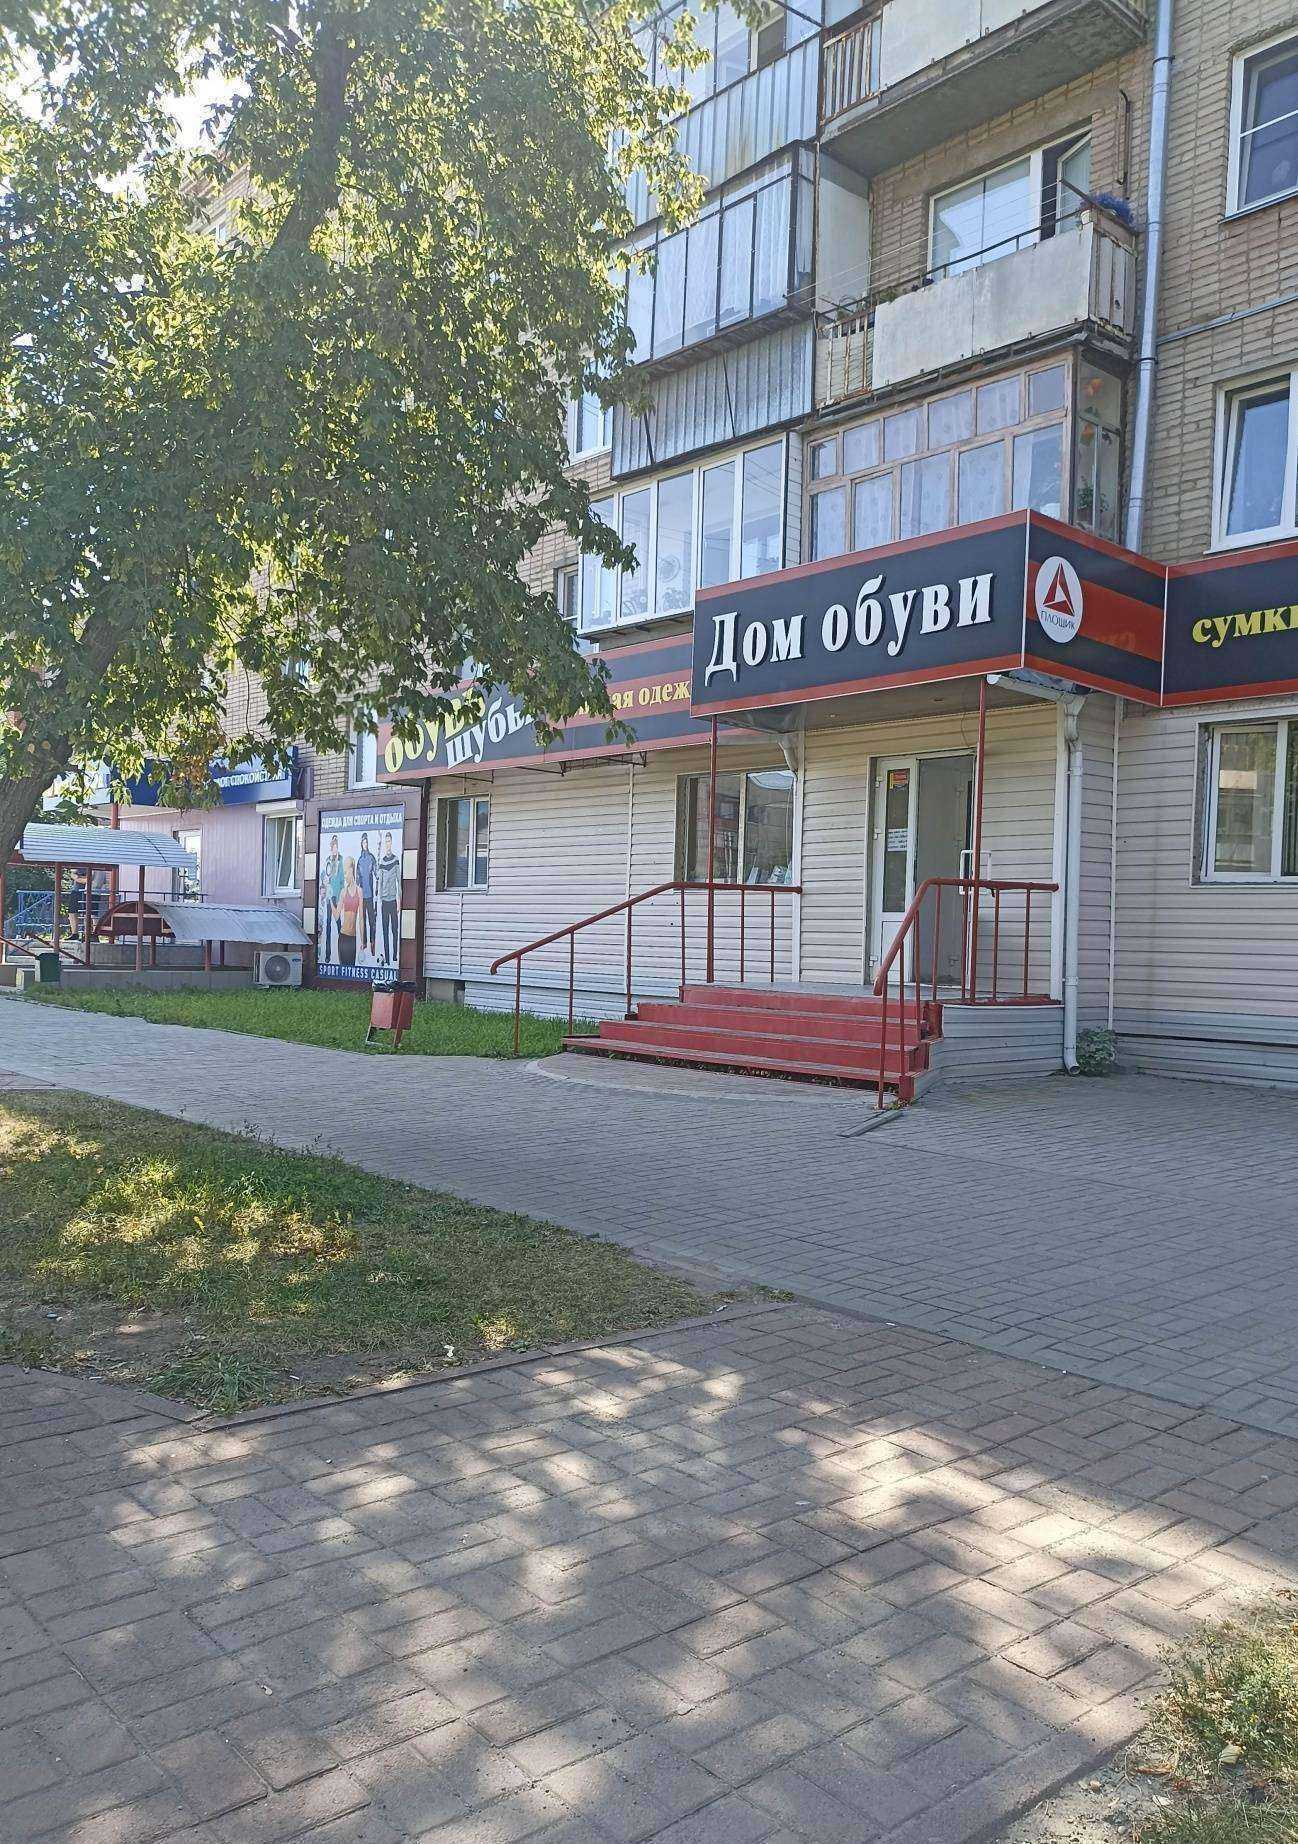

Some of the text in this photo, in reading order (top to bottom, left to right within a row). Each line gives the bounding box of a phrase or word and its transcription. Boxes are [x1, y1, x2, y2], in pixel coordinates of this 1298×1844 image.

[704, 573, 993, 687] Дом обуви
[319, 964, 398, 981] SPORT FITNESS CASUAL
